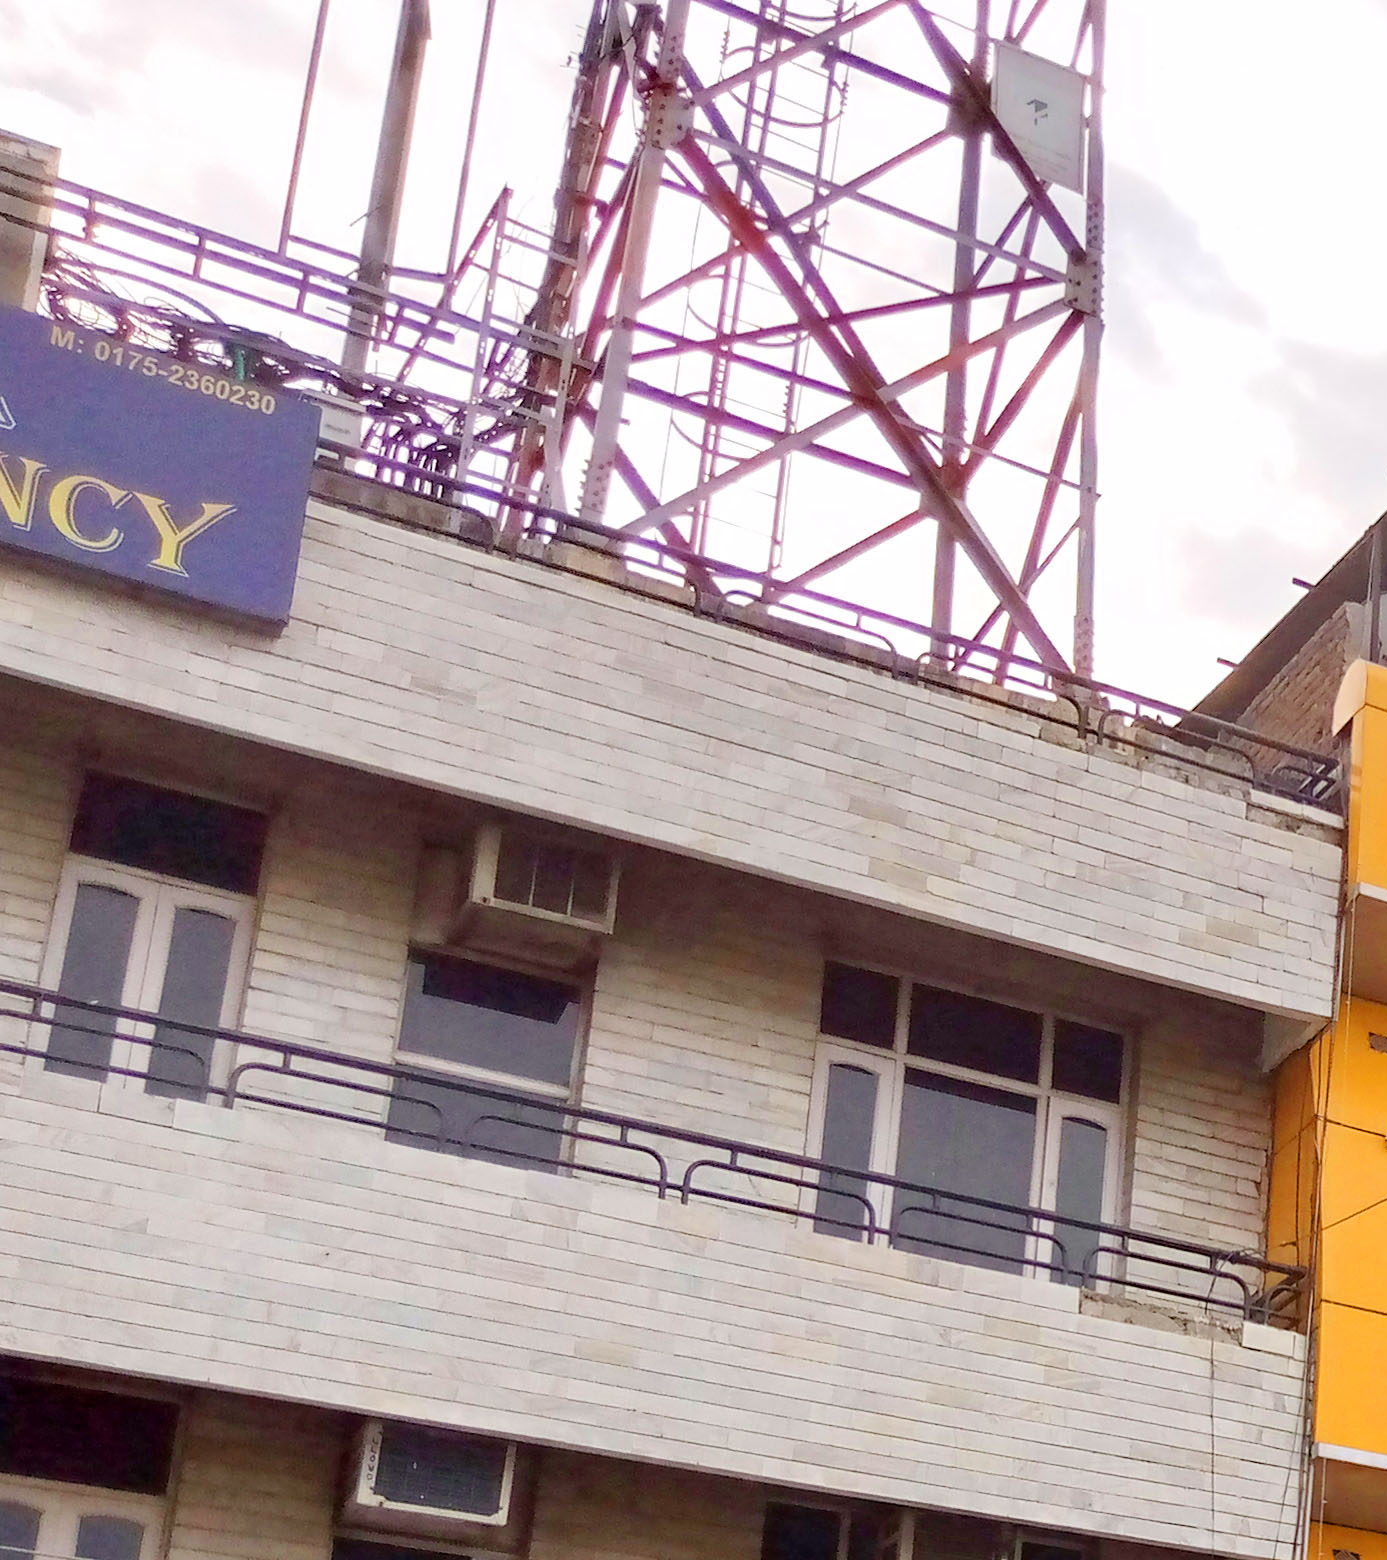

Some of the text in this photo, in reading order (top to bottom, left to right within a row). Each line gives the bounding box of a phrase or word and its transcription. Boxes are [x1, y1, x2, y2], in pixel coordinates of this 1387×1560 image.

[50, 325, 277, 416] M: 0175-2360230
[0, 454, 239, 579] NCY
